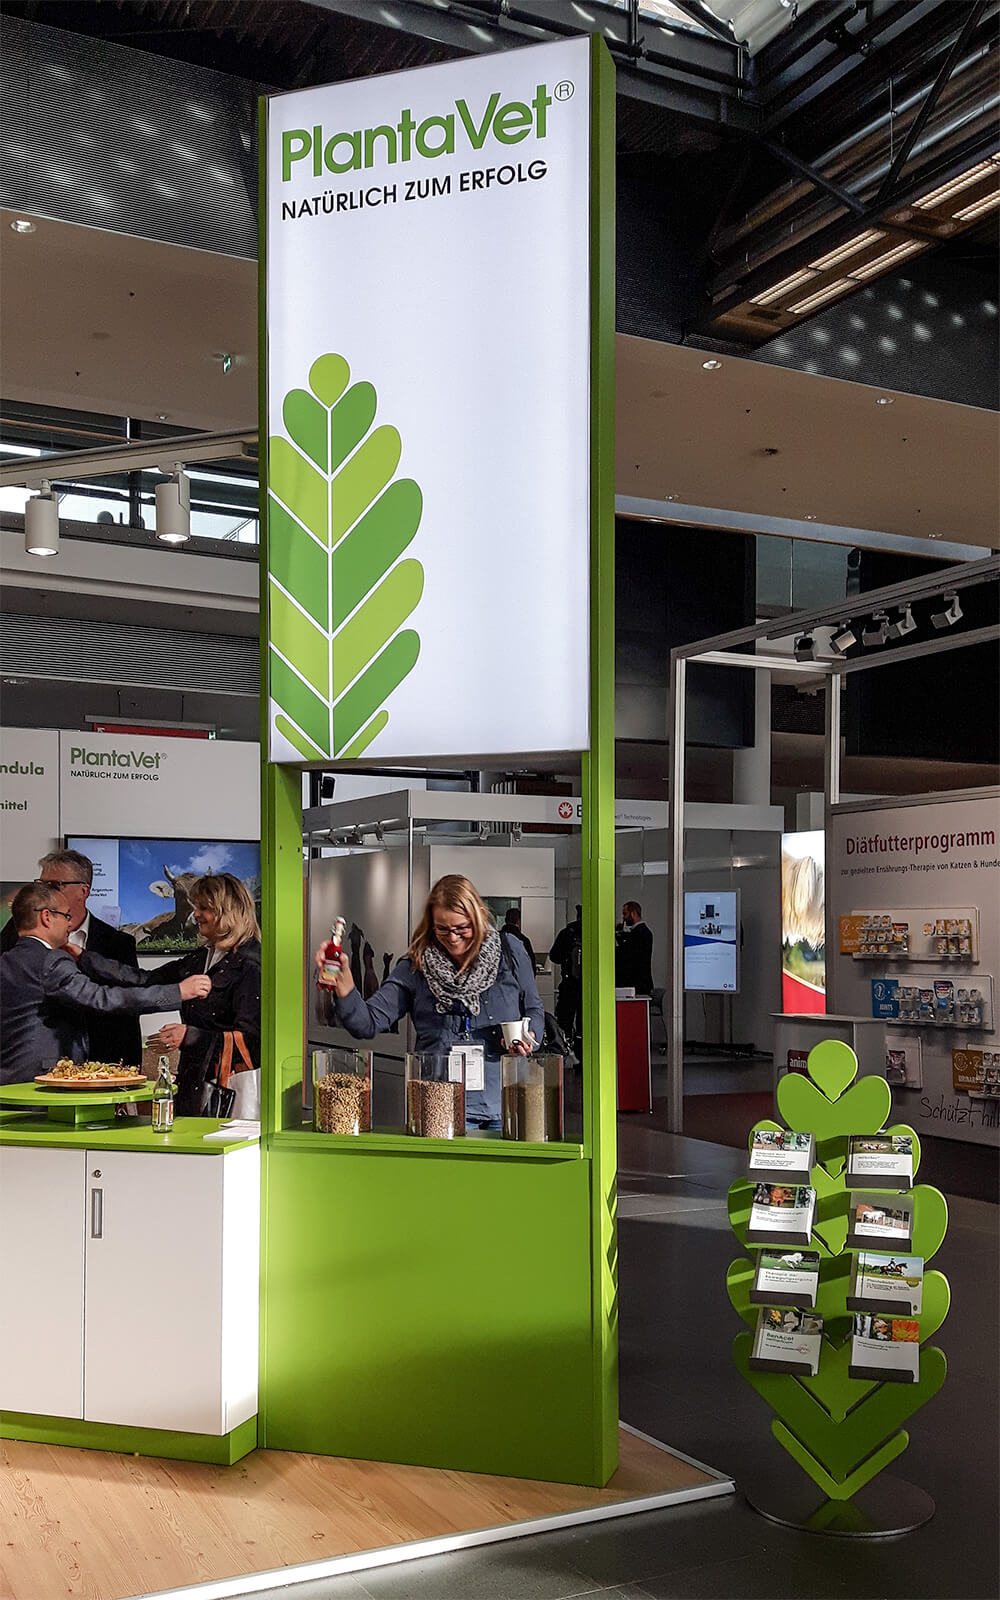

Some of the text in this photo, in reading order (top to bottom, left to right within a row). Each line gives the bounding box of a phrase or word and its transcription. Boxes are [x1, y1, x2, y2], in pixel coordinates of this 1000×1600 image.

[281, 160, 547, 220] NATÜRLICH ZUM ERFOLG
[71, 770, 111, 779] NATÜRLICH
[131, 773, 159, 781] ERFOLG
[846, 830, 995, 855] Diätfutterprogramm
[950, 861, 972, 869] Katzen
[974, 860, 978, 868] &
